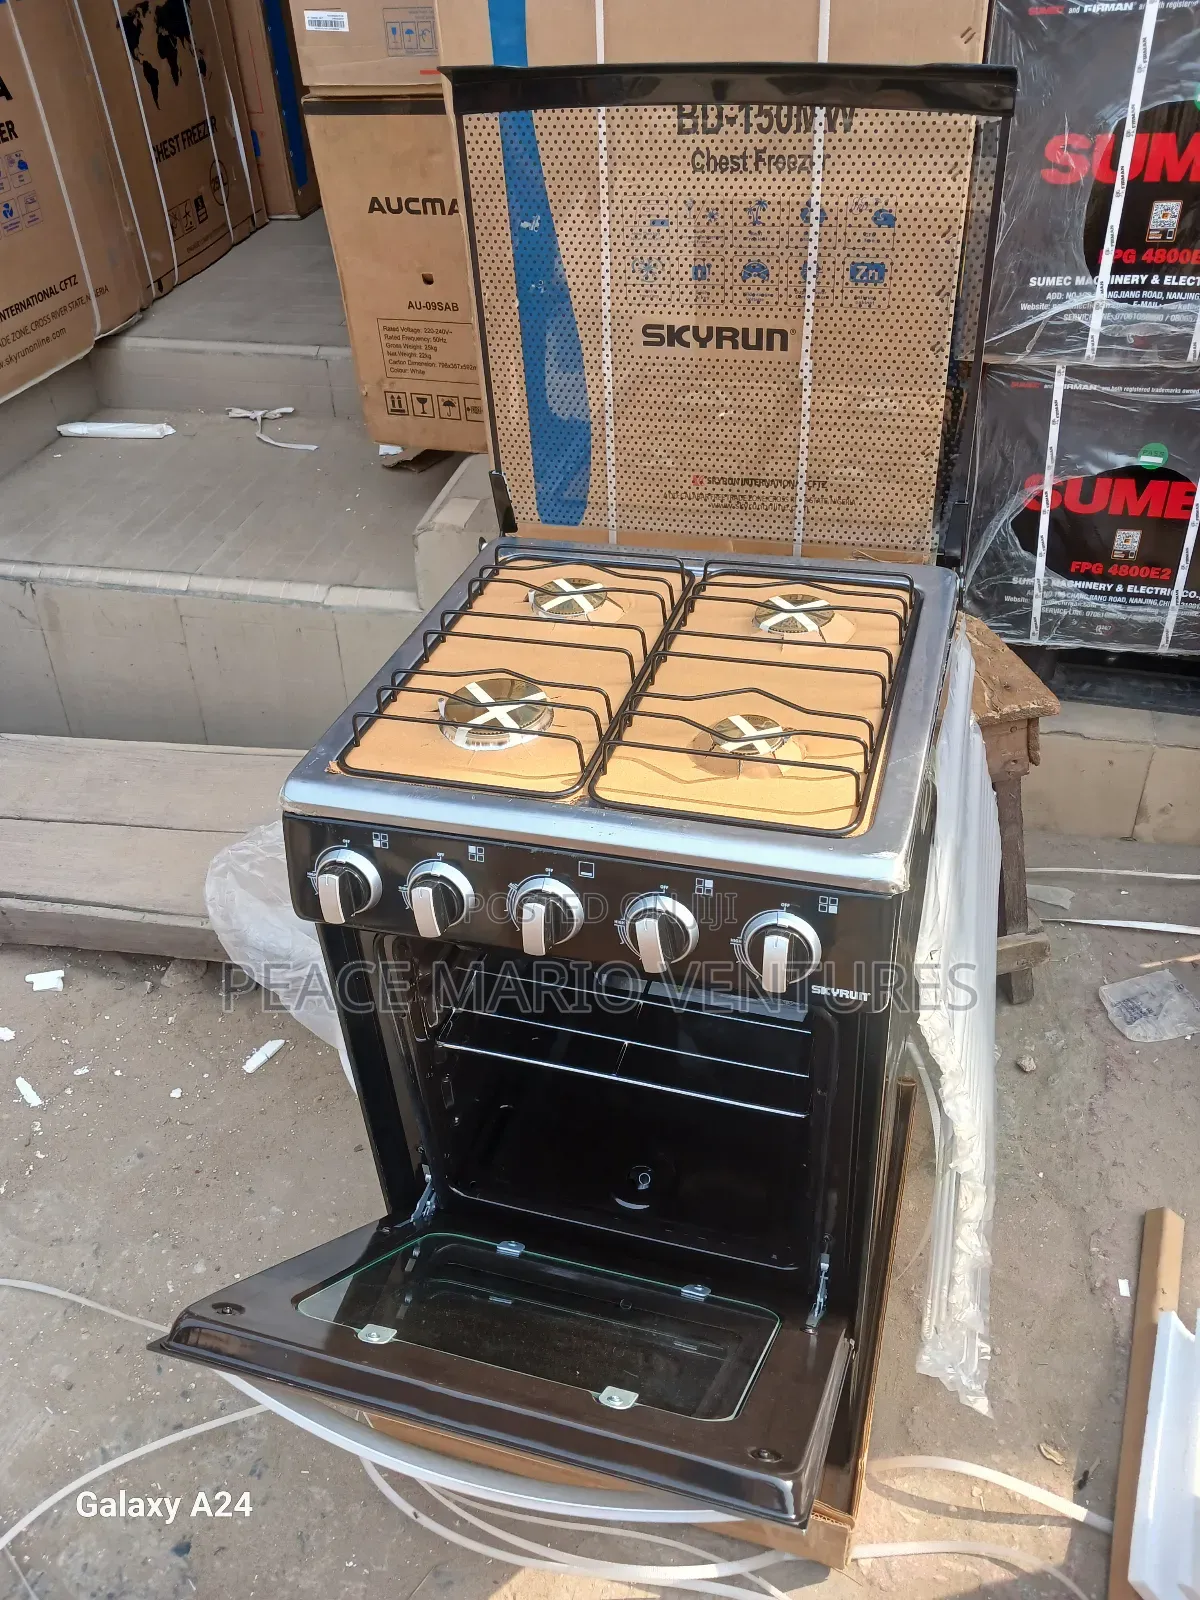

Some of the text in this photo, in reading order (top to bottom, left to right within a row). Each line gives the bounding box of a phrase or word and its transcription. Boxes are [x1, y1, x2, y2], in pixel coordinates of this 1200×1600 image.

[1068, 6, 1080, 14] and
[1083, 2, 1133, 13] FIRMAN
[691, 149, 749, 173] Chest
[855, 265, 880, 281] Zn
[59, 273, 79, 292] CFTZ
[1029, 276, 1072, 287] SUMEC
[1075, 275, 1149, 287] MACINERY
[1151, 274, 1161, 286] &
[1142, 290, 1165, 300] ROAD,
[407, 300, 460, 312] AU-09SAB
[30, 314, 52, 332] CROSS
[51, 305, 69, 321] RIVER
[410, 368, 426, 376] White
[1142, 449, 1165, 457] PASS
[1070, 561, 1173, 580] FPG 4800E2
[1115, 584, 1125, 593] &
[1108, 595, 1128, 605] ROAD,
